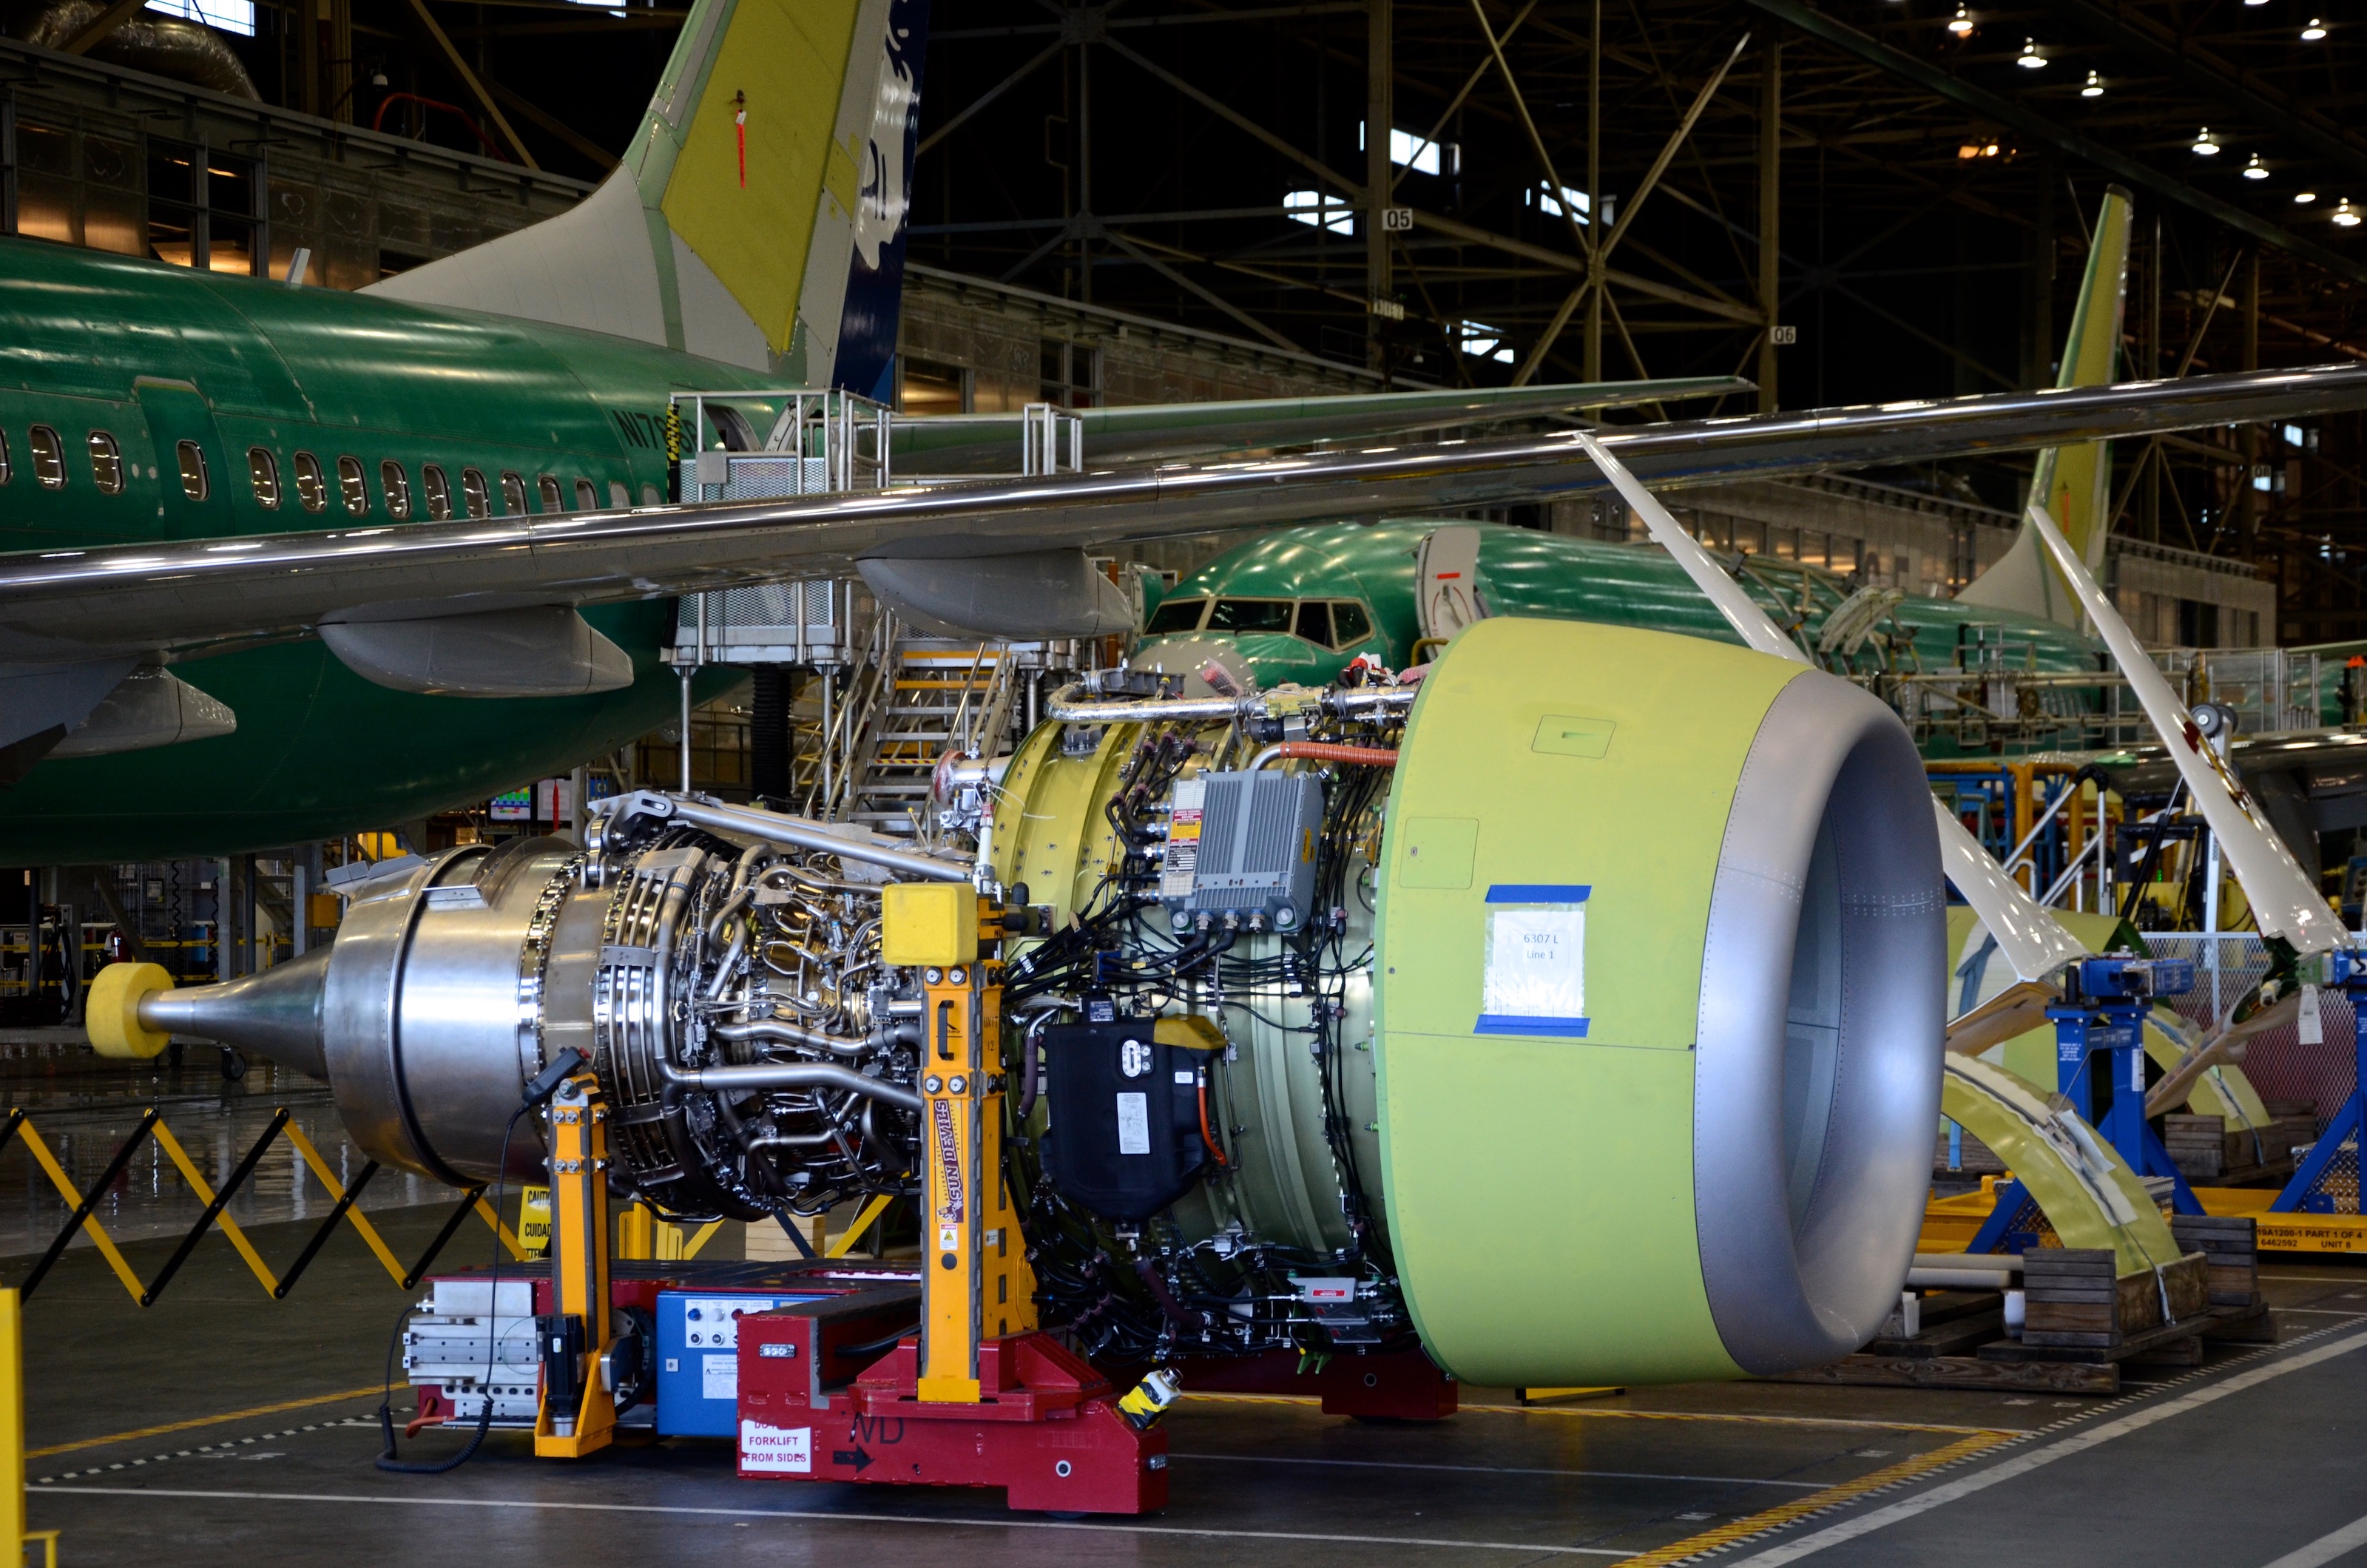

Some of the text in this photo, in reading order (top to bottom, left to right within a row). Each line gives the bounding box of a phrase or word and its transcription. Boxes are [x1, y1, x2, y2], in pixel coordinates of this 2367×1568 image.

[1387, 210, 1410, 229] Q5
[1775, 327, 1794, 342] Q6
[1524, 933, 1559, 944] 6307 L
[1527, 950, 1554, 959] Line 1
[934, 1101, 962, 1201] SUN DEVILS
[2306, 1230, 2330, 1238] PART
[2341, 1231, 2354, 1239] OF
[2261, 1239, 2297, 1247] 6462592
[749, 1436, 798, 1445] FORKLIFT
[746, 1453, 806, 1462] FROM SIDES
